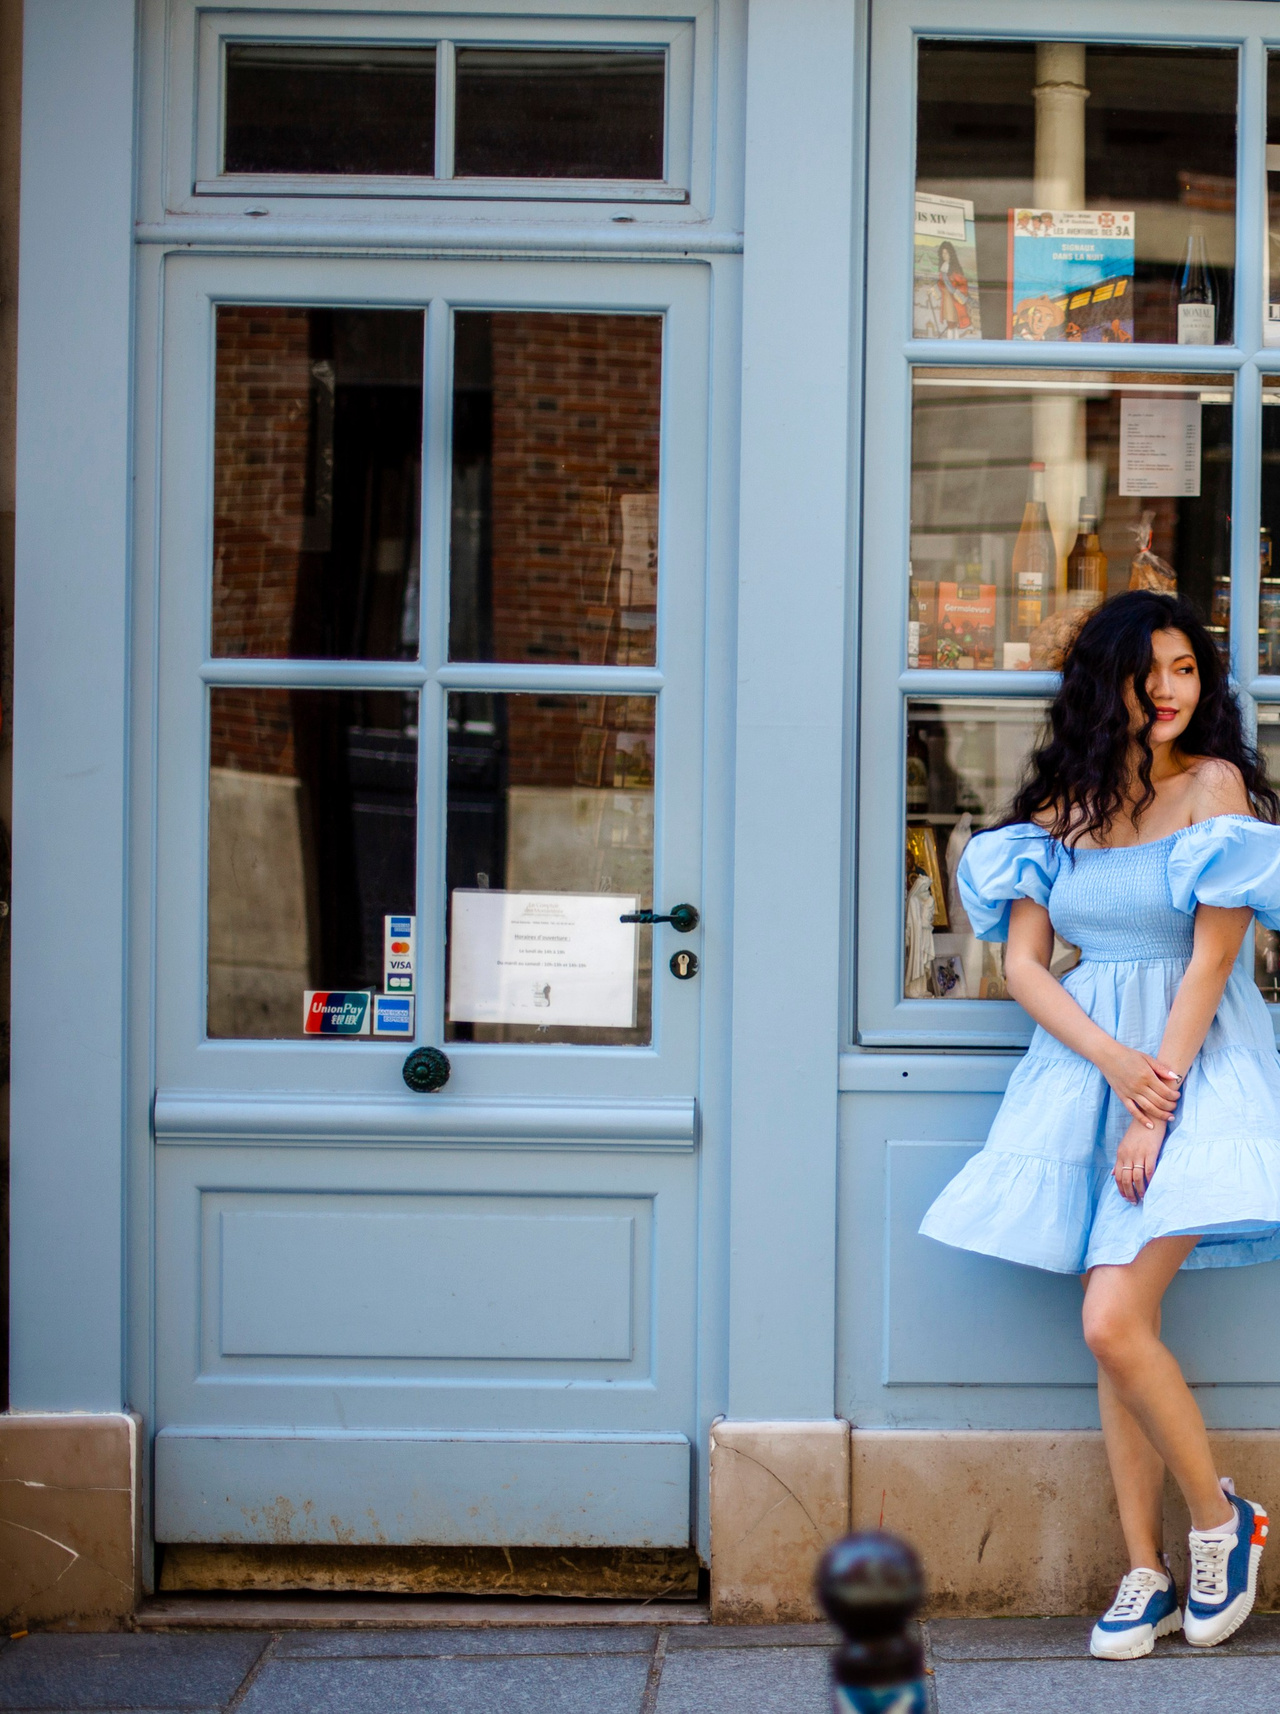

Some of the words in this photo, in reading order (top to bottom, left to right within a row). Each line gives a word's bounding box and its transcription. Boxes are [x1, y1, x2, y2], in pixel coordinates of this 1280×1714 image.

[930, 212, 949, 225] XIV
[1053, 227, 1064, 235] LES
[1067, 227, 1099, 236] AVENTURES
[1102, 228, 1113, 236] DES
[1061, 243, 1095, 252] SIGNAUX
[1052, 252, 1073, 260] DANS
[1086, 253, 1104, 261] NUIT
[390, 961, 412, 970] VISA
[312, 1002, 363, 1018] UnionPay
